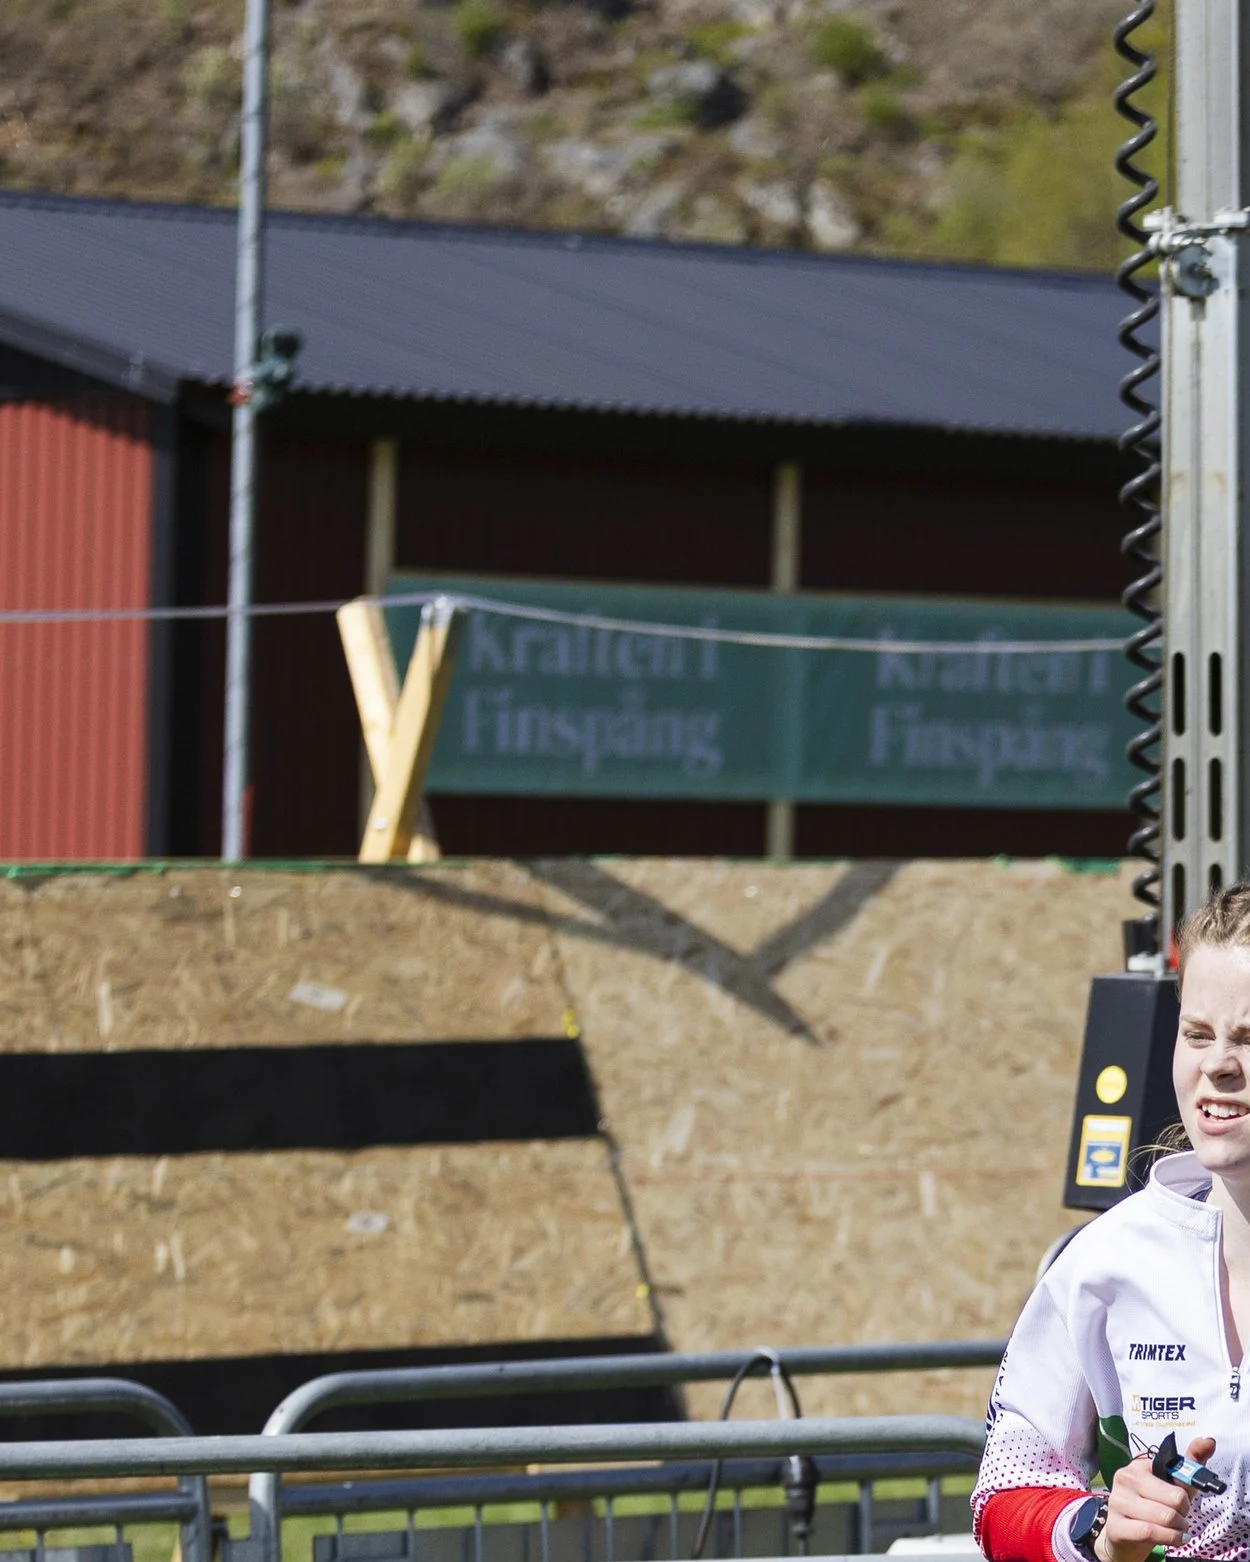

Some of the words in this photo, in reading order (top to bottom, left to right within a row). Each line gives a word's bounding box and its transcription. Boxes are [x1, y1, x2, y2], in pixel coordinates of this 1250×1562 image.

[461, 687, 723, 779] Finspång
[869, 704, 1111, 787] Finspång
[1129, 1344, 1186, 1361] TRIMTEX
[1140, 1396, 1196, 1411] TIGER
[1141, 1411, 1179, 1420] SPORTS
